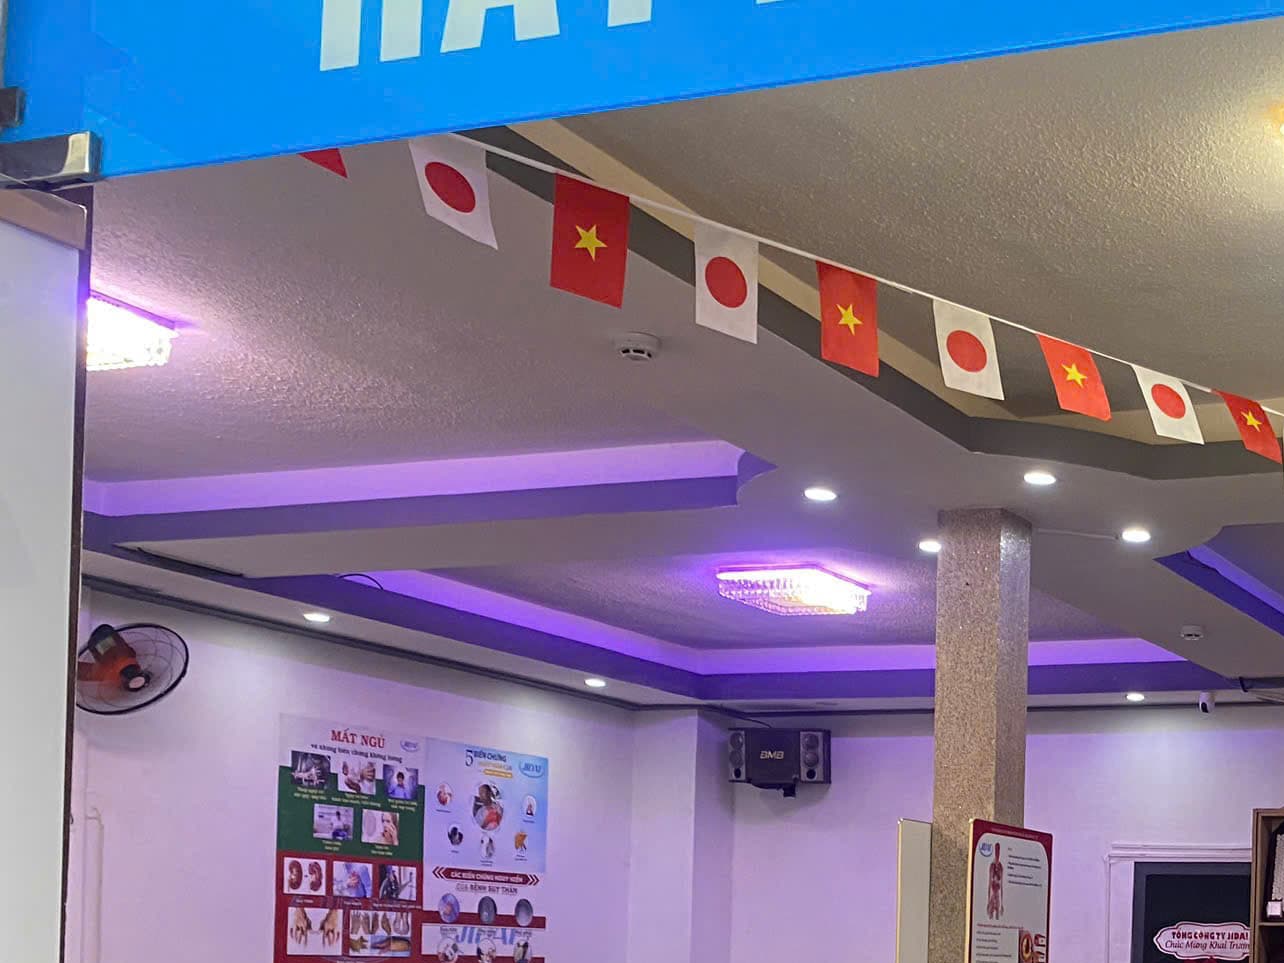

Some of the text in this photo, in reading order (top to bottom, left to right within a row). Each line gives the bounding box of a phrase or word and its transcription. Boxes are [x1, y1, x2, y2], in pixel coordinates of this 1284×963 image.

[465, 749, 474, 767] 5
[760, 750, 784, 760] BMB
[1215, 931, 1226, 940] TY
